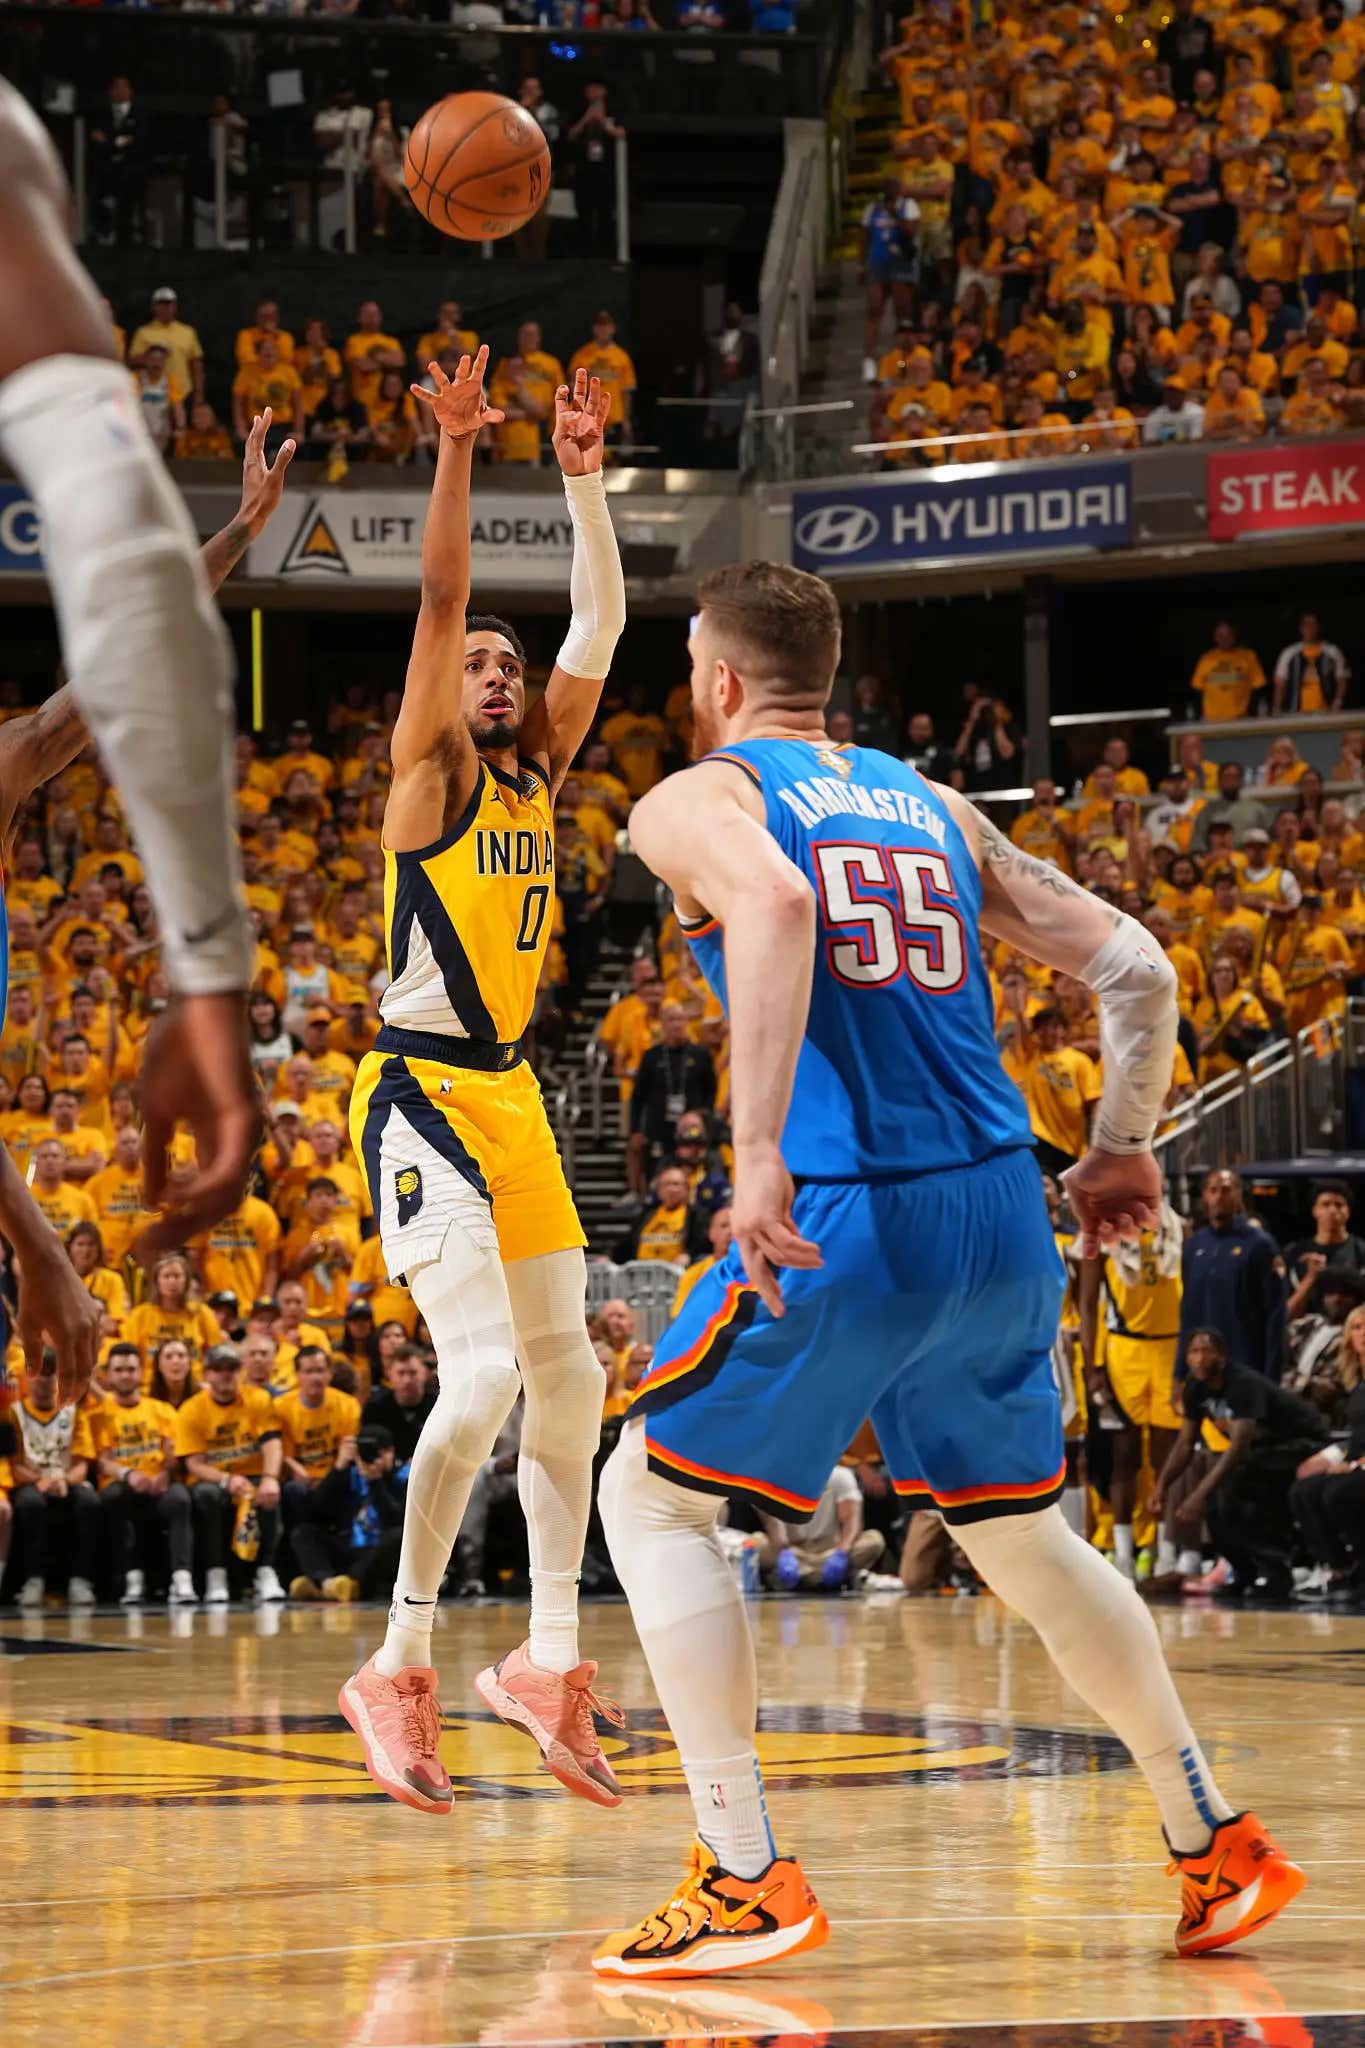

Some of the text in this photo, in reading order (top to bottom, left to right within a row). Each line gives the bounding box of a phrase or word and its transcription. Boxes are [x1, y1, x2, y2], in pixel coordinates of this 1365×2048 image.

[892, 483, 1127, 545] HYUNDAI
[1219, 464, 1361, 515] STEAK
[351, 517, 574, 545] LIFT ADEMY
[515, 884, 551, 953] 0
[810, 840, 969, 995] 55
